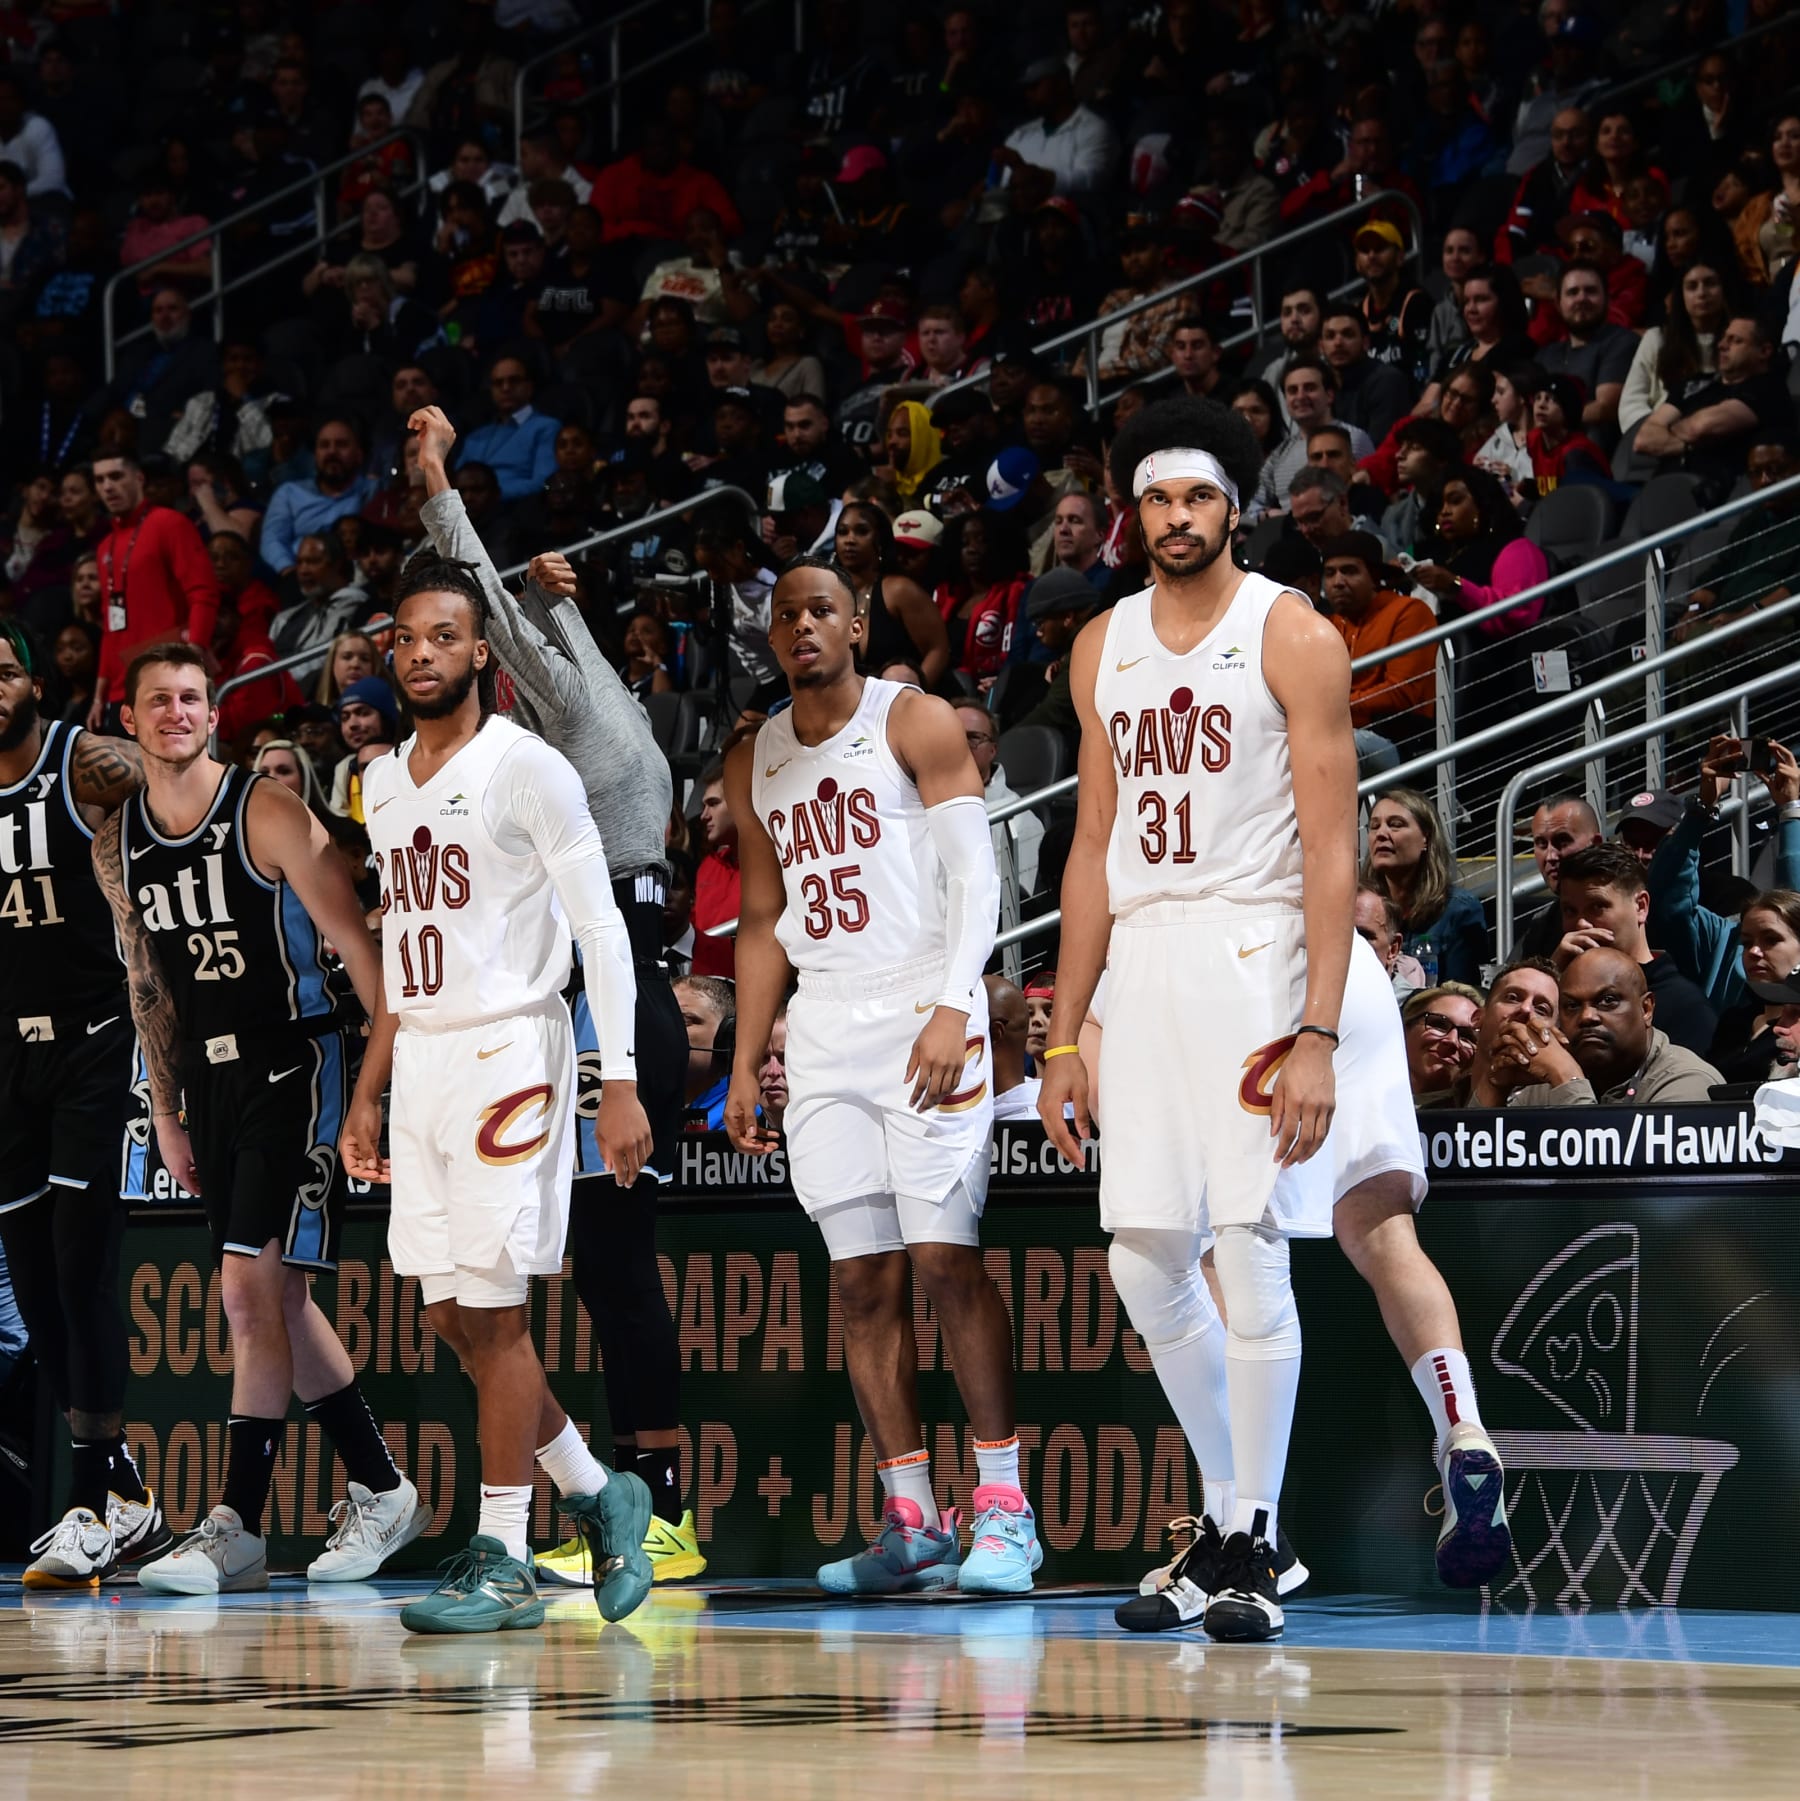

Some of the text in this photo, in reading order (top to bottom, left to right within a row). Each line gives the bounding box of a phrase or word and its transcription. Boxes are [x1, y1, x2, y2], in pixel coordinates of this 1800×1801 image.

[1212, 662, 1246, 670] CLIFFS
[843, 748, 873, 758] CLIFFS
[1110, 703, 1232, 777] CAVS
[440, 808, 469, 816] CLIFFS
[768, 787, 881, 869] CAVS
[1137, 790, 1197, 864] 31
[0, 875, 65, 928] 41
[138, 853, 235, 932] atl
[375, 843, 471, 916] CAVS
[801, 864, 870, 940] 35
[187, 930, 246, 981] 25
[399, 925, 443, 998] 10
[336, 1259, 438, 1374] BIG
[813, 1422, 978, 1550] JON
[1014, 1423, 1204, 1552] TODA
